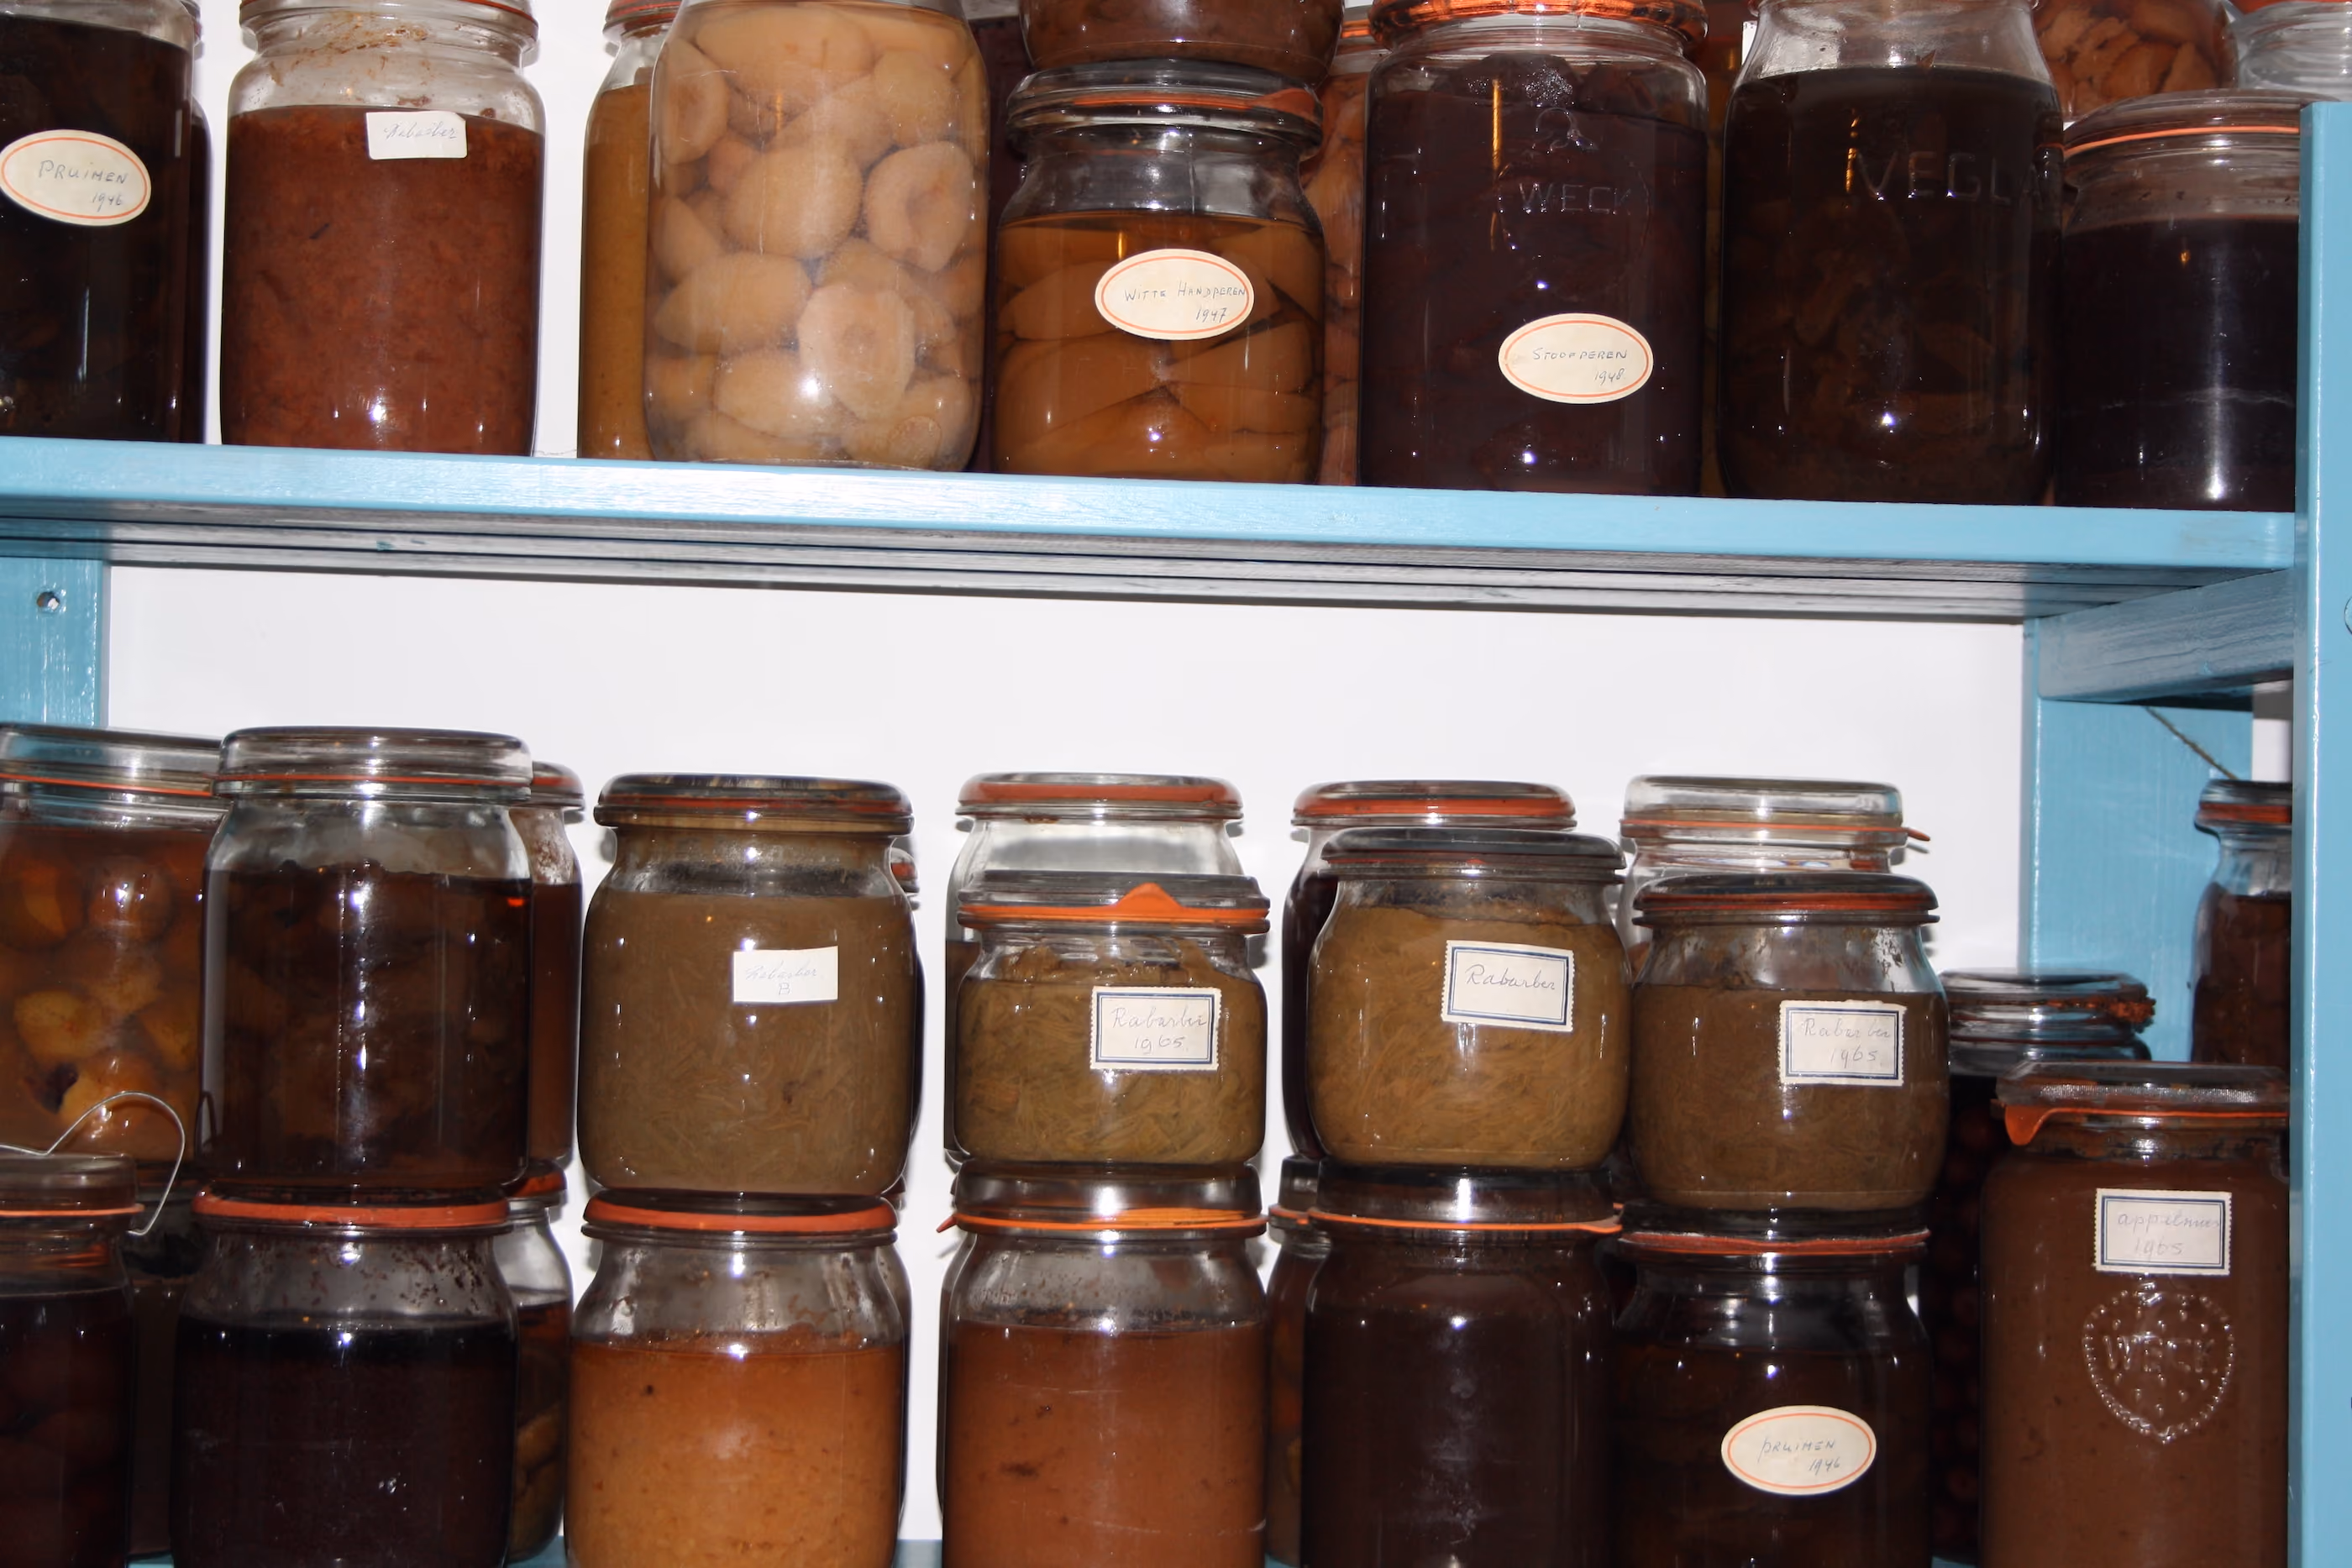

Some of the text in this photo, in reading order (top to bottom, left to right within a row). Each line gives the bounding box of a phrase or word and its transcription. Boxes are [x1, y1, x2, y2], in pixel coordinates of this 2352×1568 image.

[92, 192, 124, 212] 1946
[1519, 182, 1631, 216] WECK
[1195, 307, 1227, 323] 1947
[1595, 368, 1625, 386] 1948
[1465, 963, 1555, 990] Rabarber
[1135, 1034, 1185, 1055] 1965
[1830, 1044, 1878, 1069] 1965
[2134, 1235, 2184, 1262] 1965
[2103, 1333, 2218, 1375] WECK
[1809, 1456, 1841, 1476] 1946
